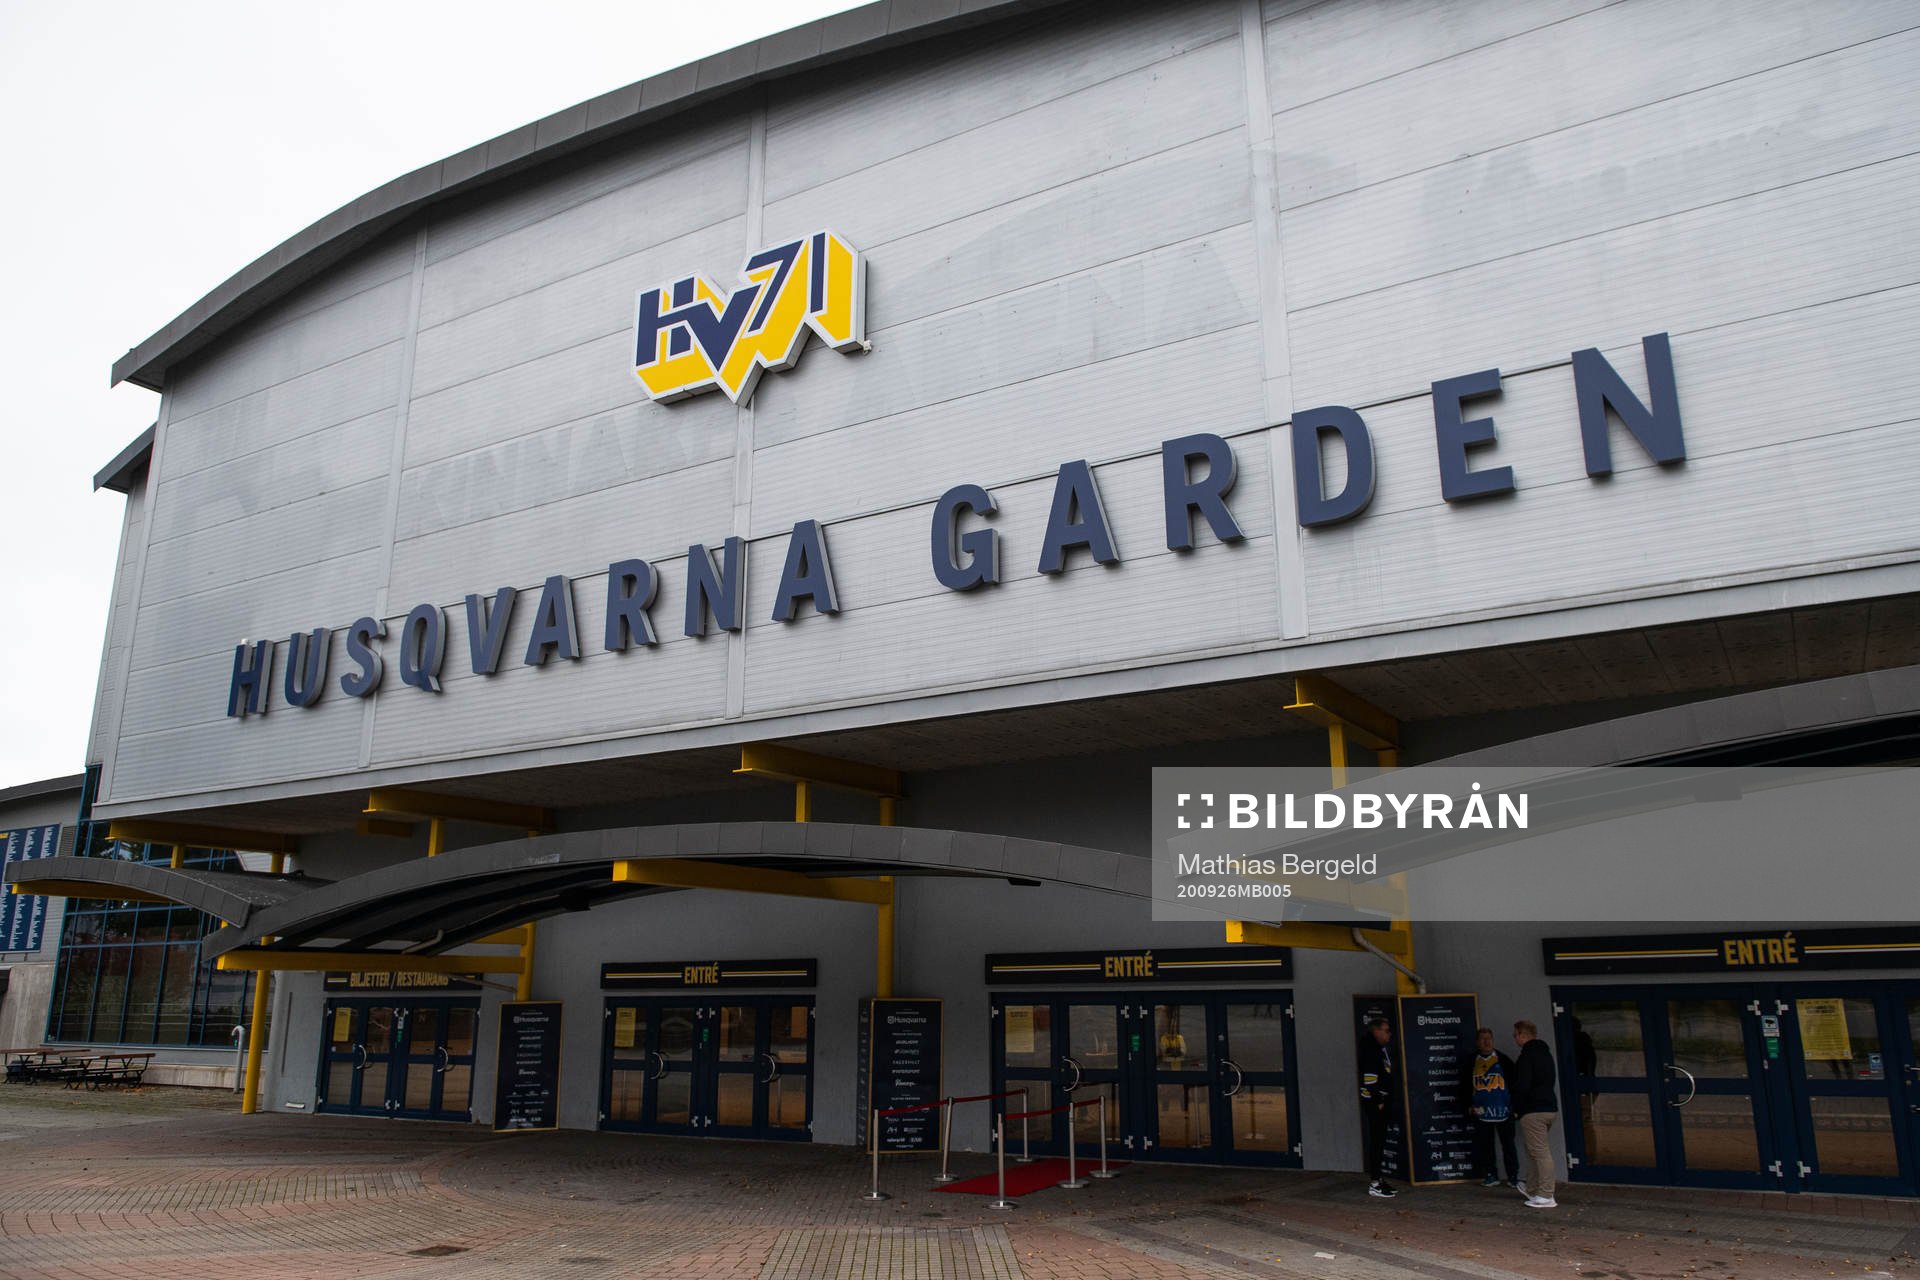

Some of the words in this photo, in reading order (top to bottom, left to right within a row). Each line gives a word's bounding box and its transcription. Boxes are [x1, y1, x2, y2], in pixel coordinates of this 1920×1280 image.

[634, 229, 858, 404] HV71
[227, 519, 840, 717] HUSQVARNA
[931, 332, 1686, 592] GARDEN
[1723, 932, 1799, 966] ENTRÉ
[684, 961, 719, 984] ENTRÉ
[1104, 950, 1153, 977] ENTRÉ
[350, 971, 390, 987] BILJETTER
[894, 1015, 927, 1024] Husqvarna
[1425, 1015, 1461, 1025] Husqvarna
